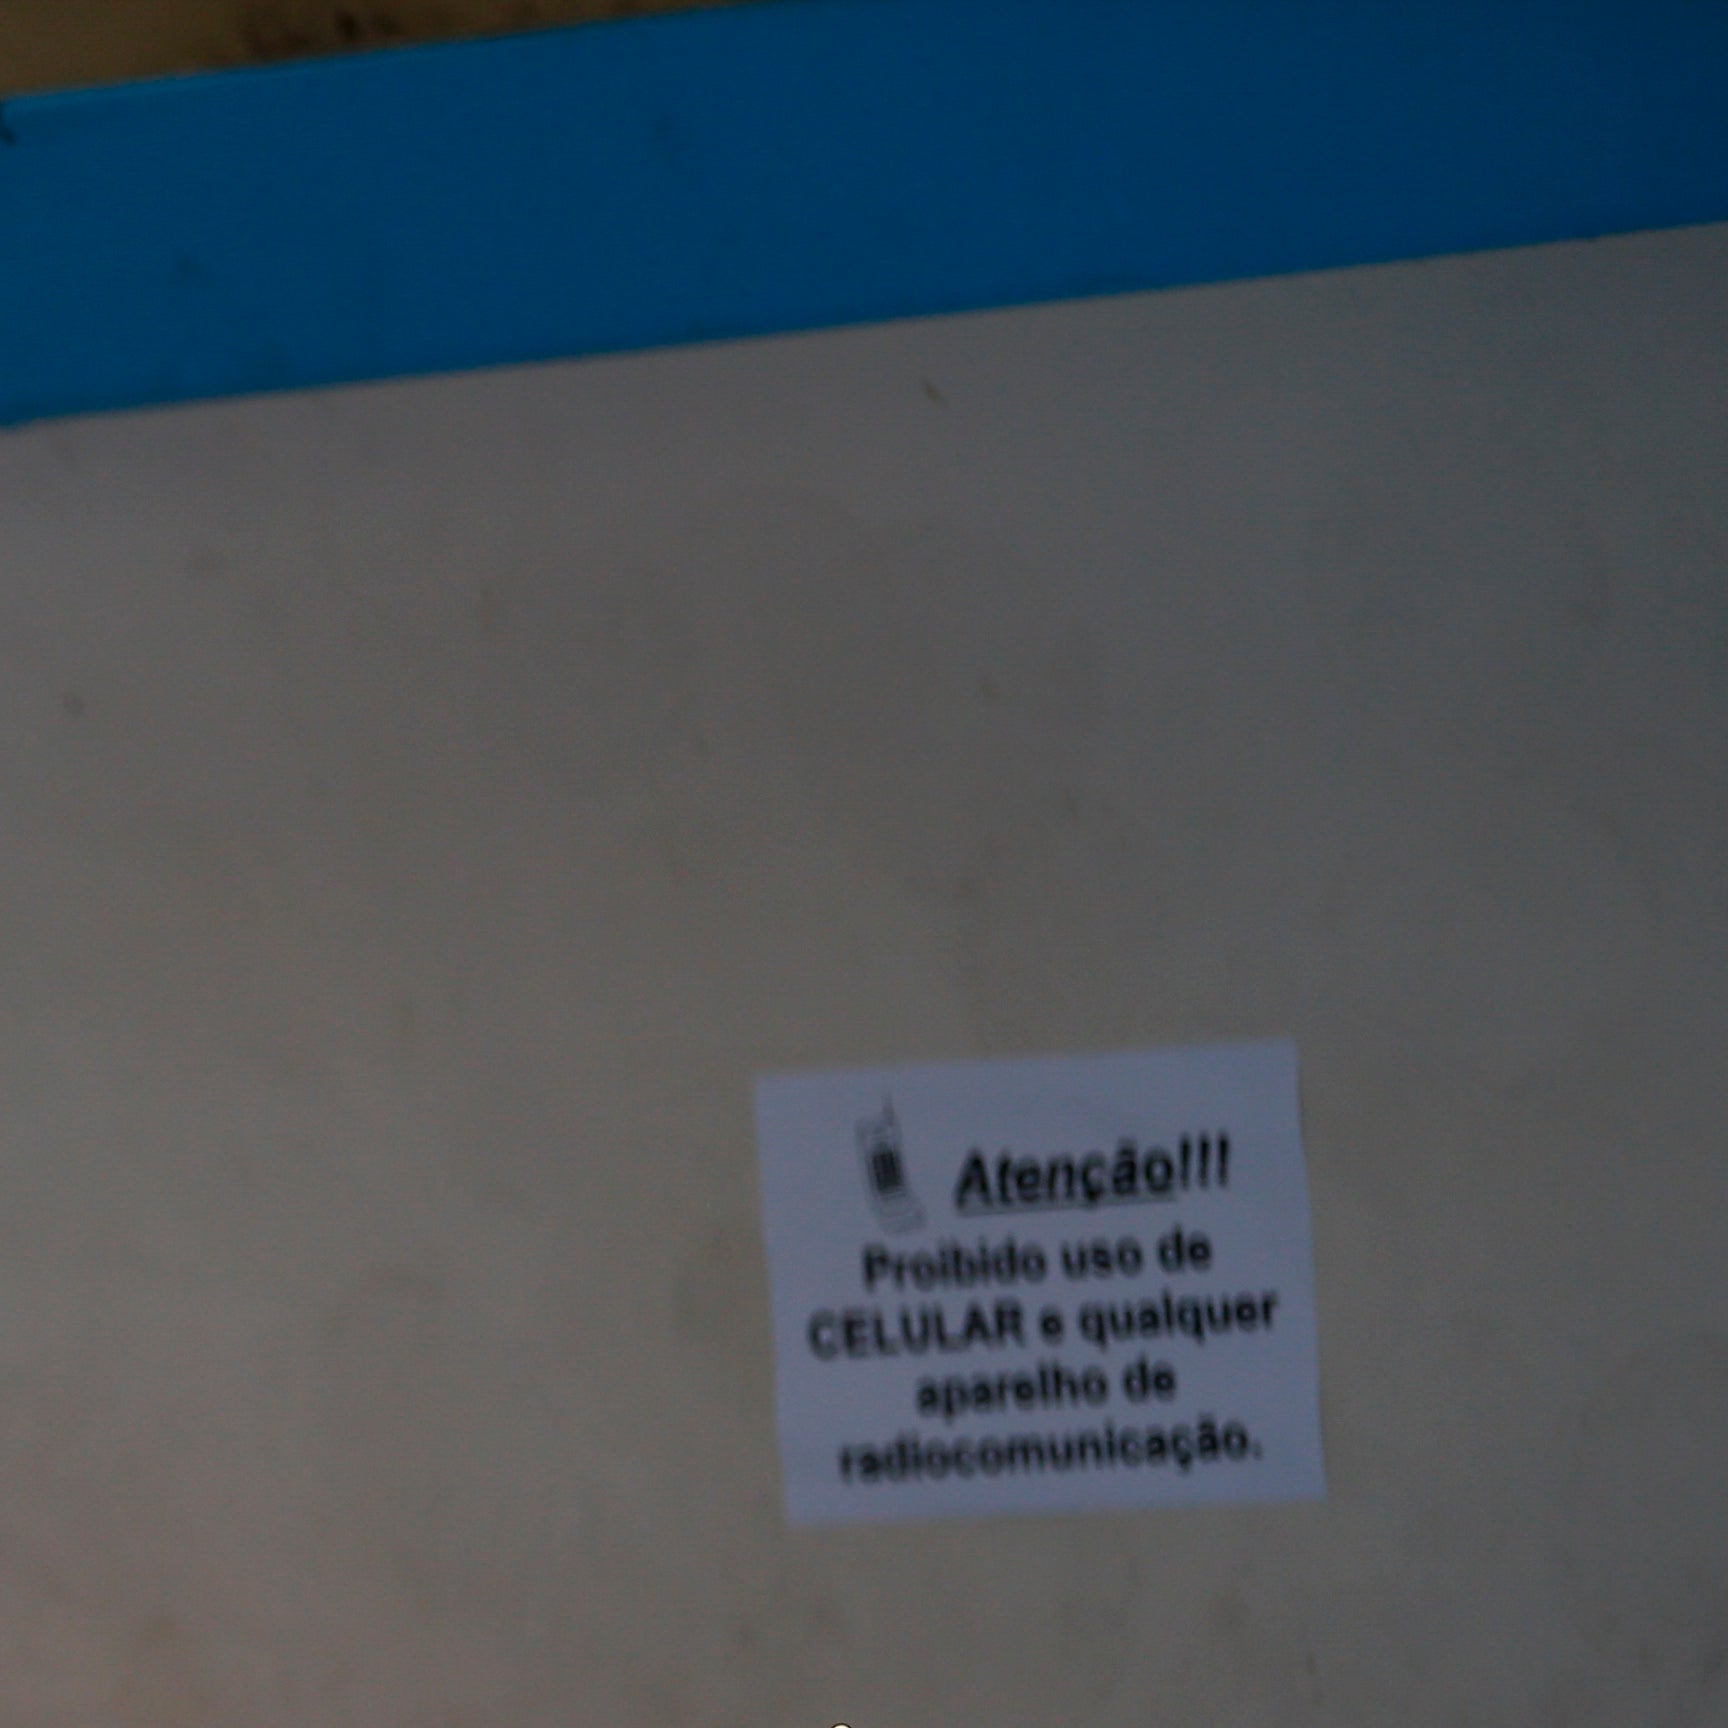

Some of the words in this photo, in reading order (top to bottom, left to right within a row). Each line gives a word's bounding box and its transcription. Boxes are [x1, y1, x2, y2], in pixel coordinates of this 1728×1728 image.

[951, 1129, 1231, 1211] Atenção!!!
[860, 1234, 1046, 1292] Proibido
[1061, 1237, 1142, 1277] uso
[1157, 1223, 1213, 1273] de
[806, 1301, 1026, 1361] CELULAR
[1039, 1312, 1065, 1346] e
[1079, 1287, 1279, 1348] qualquer
[915, 1358, 1108, 1422] aparelho
[1122, 1351, 1177, 1400] de
[838, 1413, 1264, 1485] radiocomunicação.
